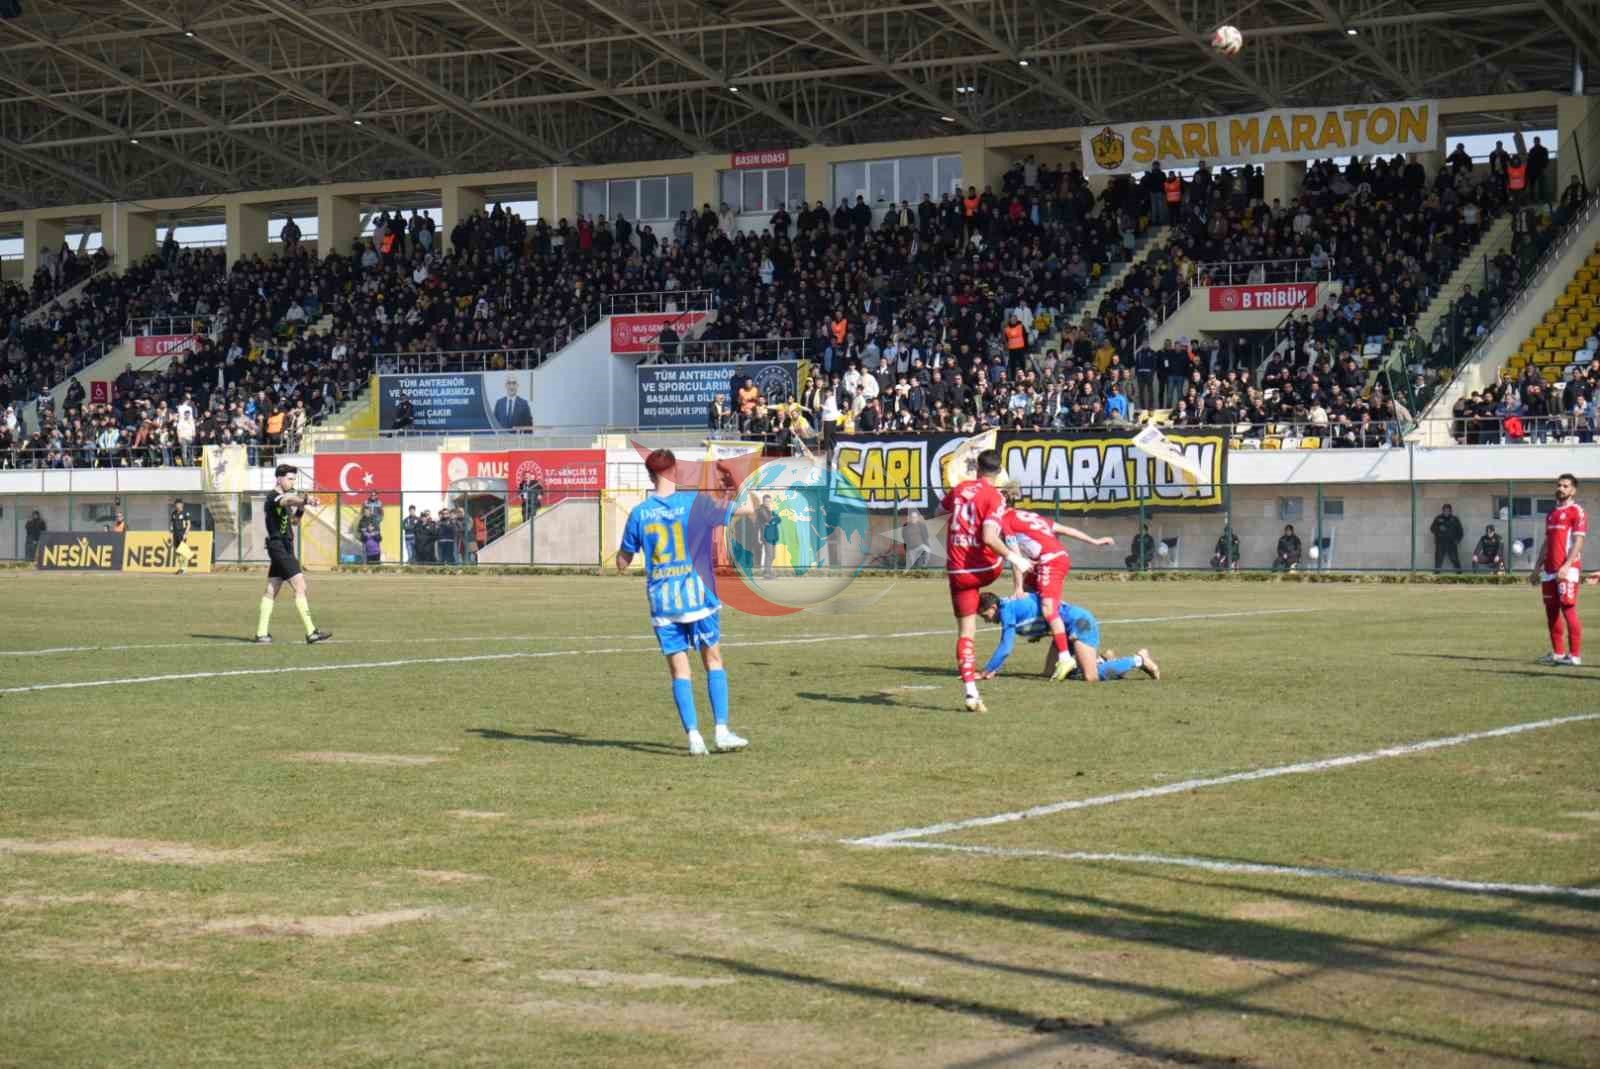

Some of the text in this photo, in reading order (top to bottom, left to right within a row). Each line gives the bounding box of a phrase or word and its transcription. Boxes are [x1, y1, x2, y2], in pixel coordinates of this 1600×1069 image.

[1130, 105, 1429, 162] SARI MARATON
[1242, 287, 1308, 308] B TRİBÜN
[654, 370, 677, 382] TÜM
[399, 377, 465, 388] TÜM ANTRENÖR
[642, 383, 656, 392] VE
[389, 389, 400, 398] VE
[646, 394, 696, 405] BAŞARILAR
[836, 446, 921, 501] SARI
[644, 521, 687, 564] 21
